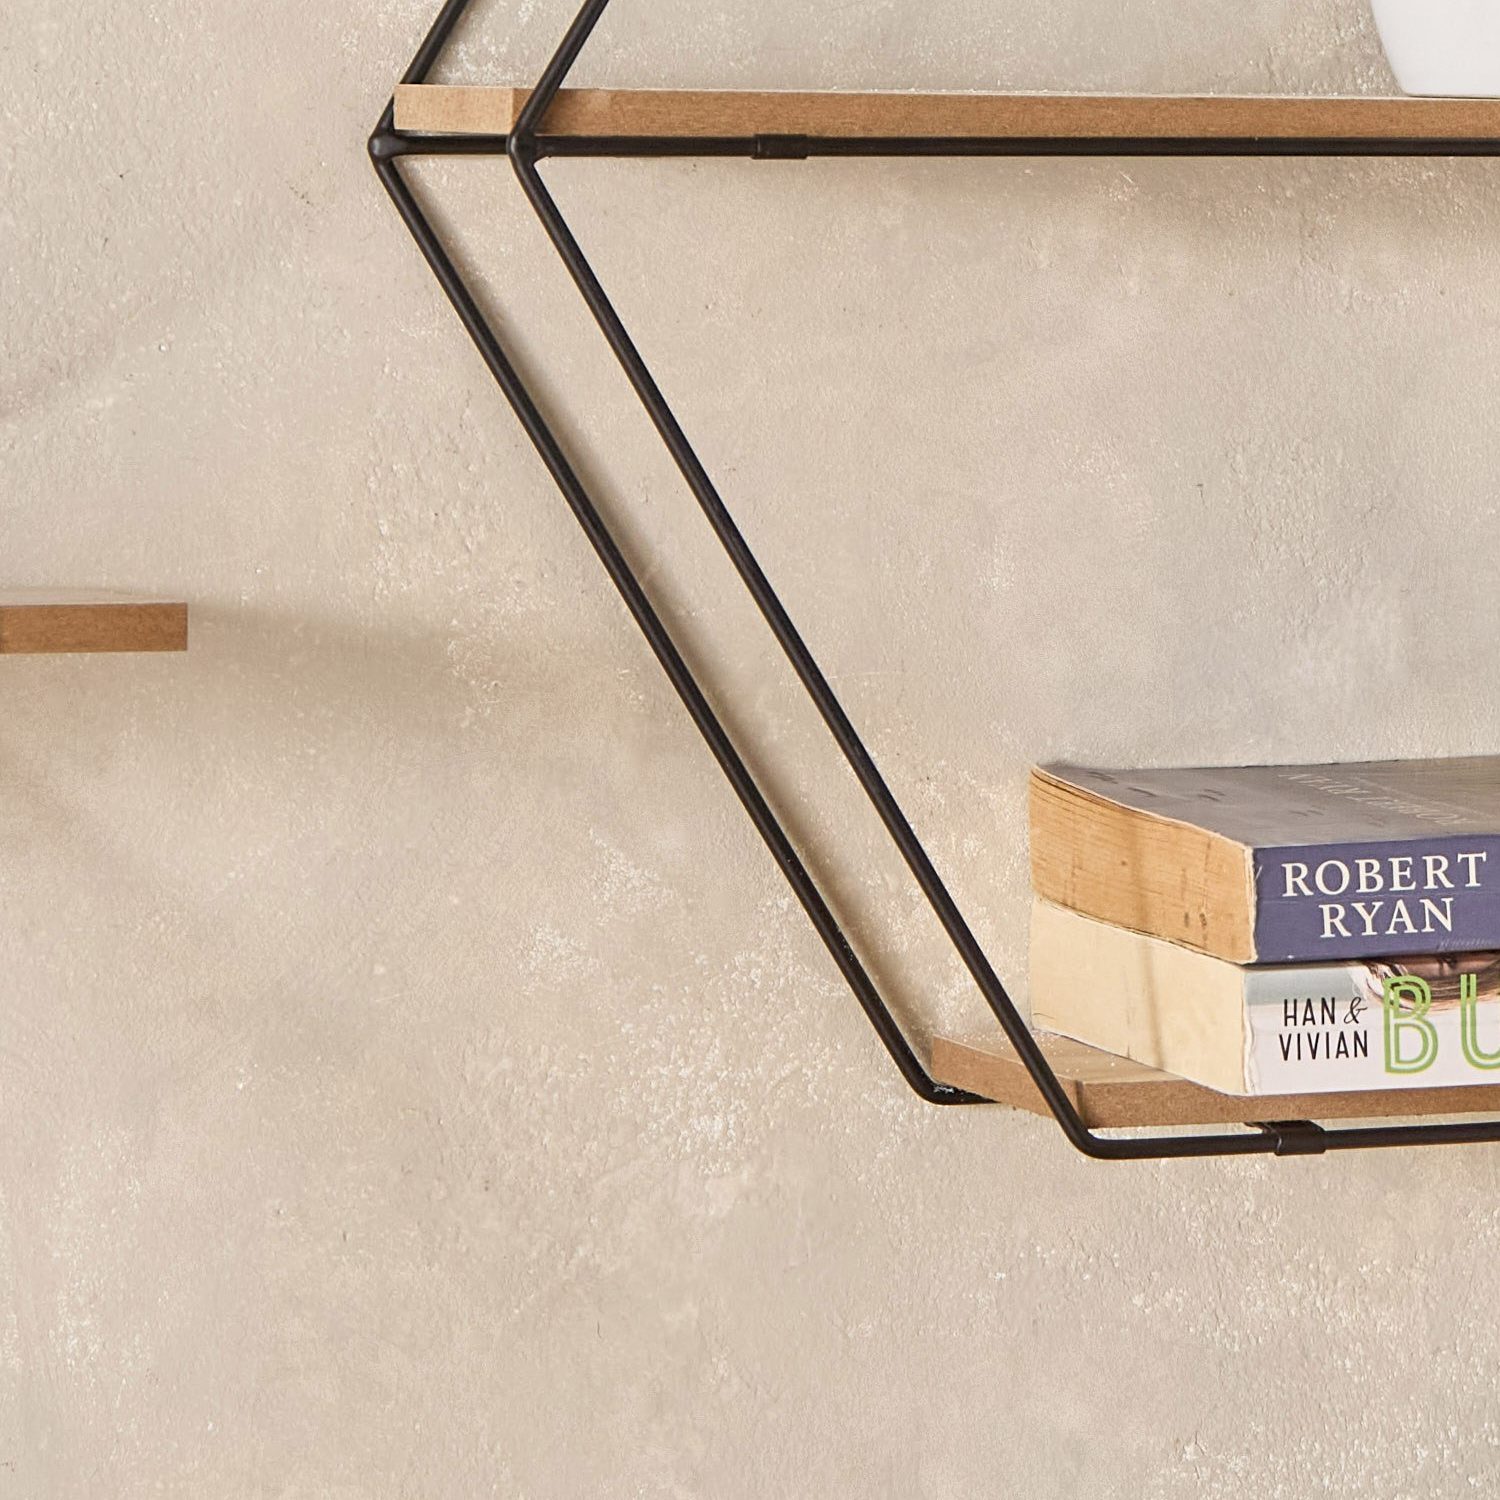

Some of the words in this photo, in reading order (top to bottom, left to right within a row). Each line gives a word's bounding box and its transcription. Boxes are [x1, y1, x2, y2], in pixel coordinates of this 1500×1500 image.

[1281, 851, 1487, 897] ROBERT
[1318, 897, 1453, 938] RYAN
[1283, 997, 1336, 1027] HAN
[1343, 996, 1369, 1024] &
[1279, 1030, 1368, 1061] VIVIAN
